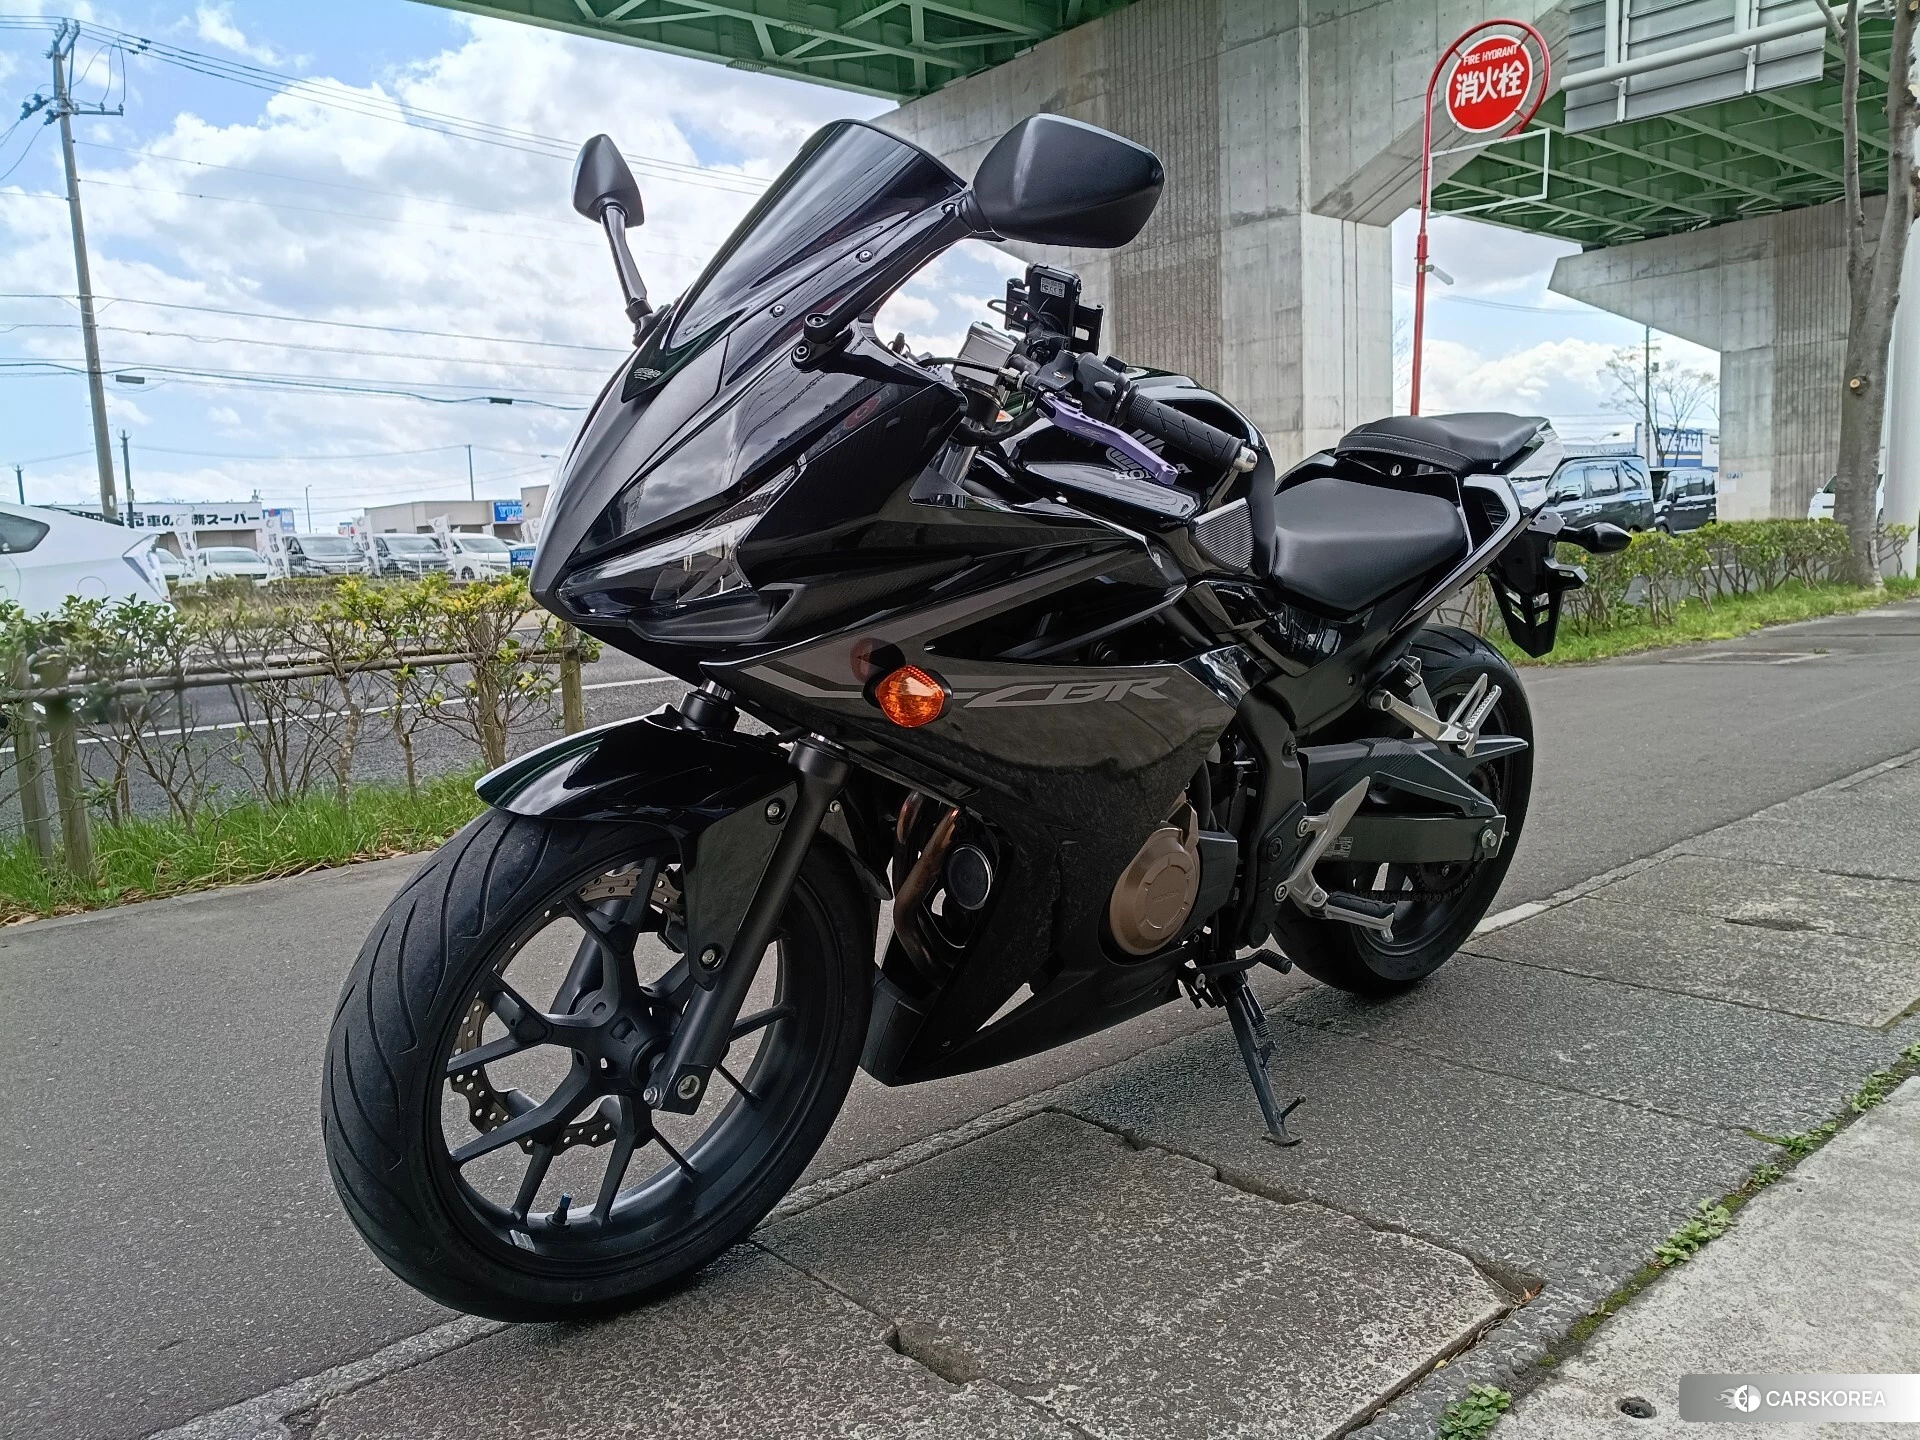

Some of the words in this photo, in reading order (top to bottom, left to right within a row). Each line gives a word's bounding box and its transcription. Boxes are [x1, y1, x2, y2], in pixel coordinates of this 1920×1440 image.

[1463, 53, 1481, 66] FIRE
[1482, 44, 1518, 62] HYDRANT
[1454, 60, 1525, 108] 消火栓
[963, 677, 1170, 707] CBR
